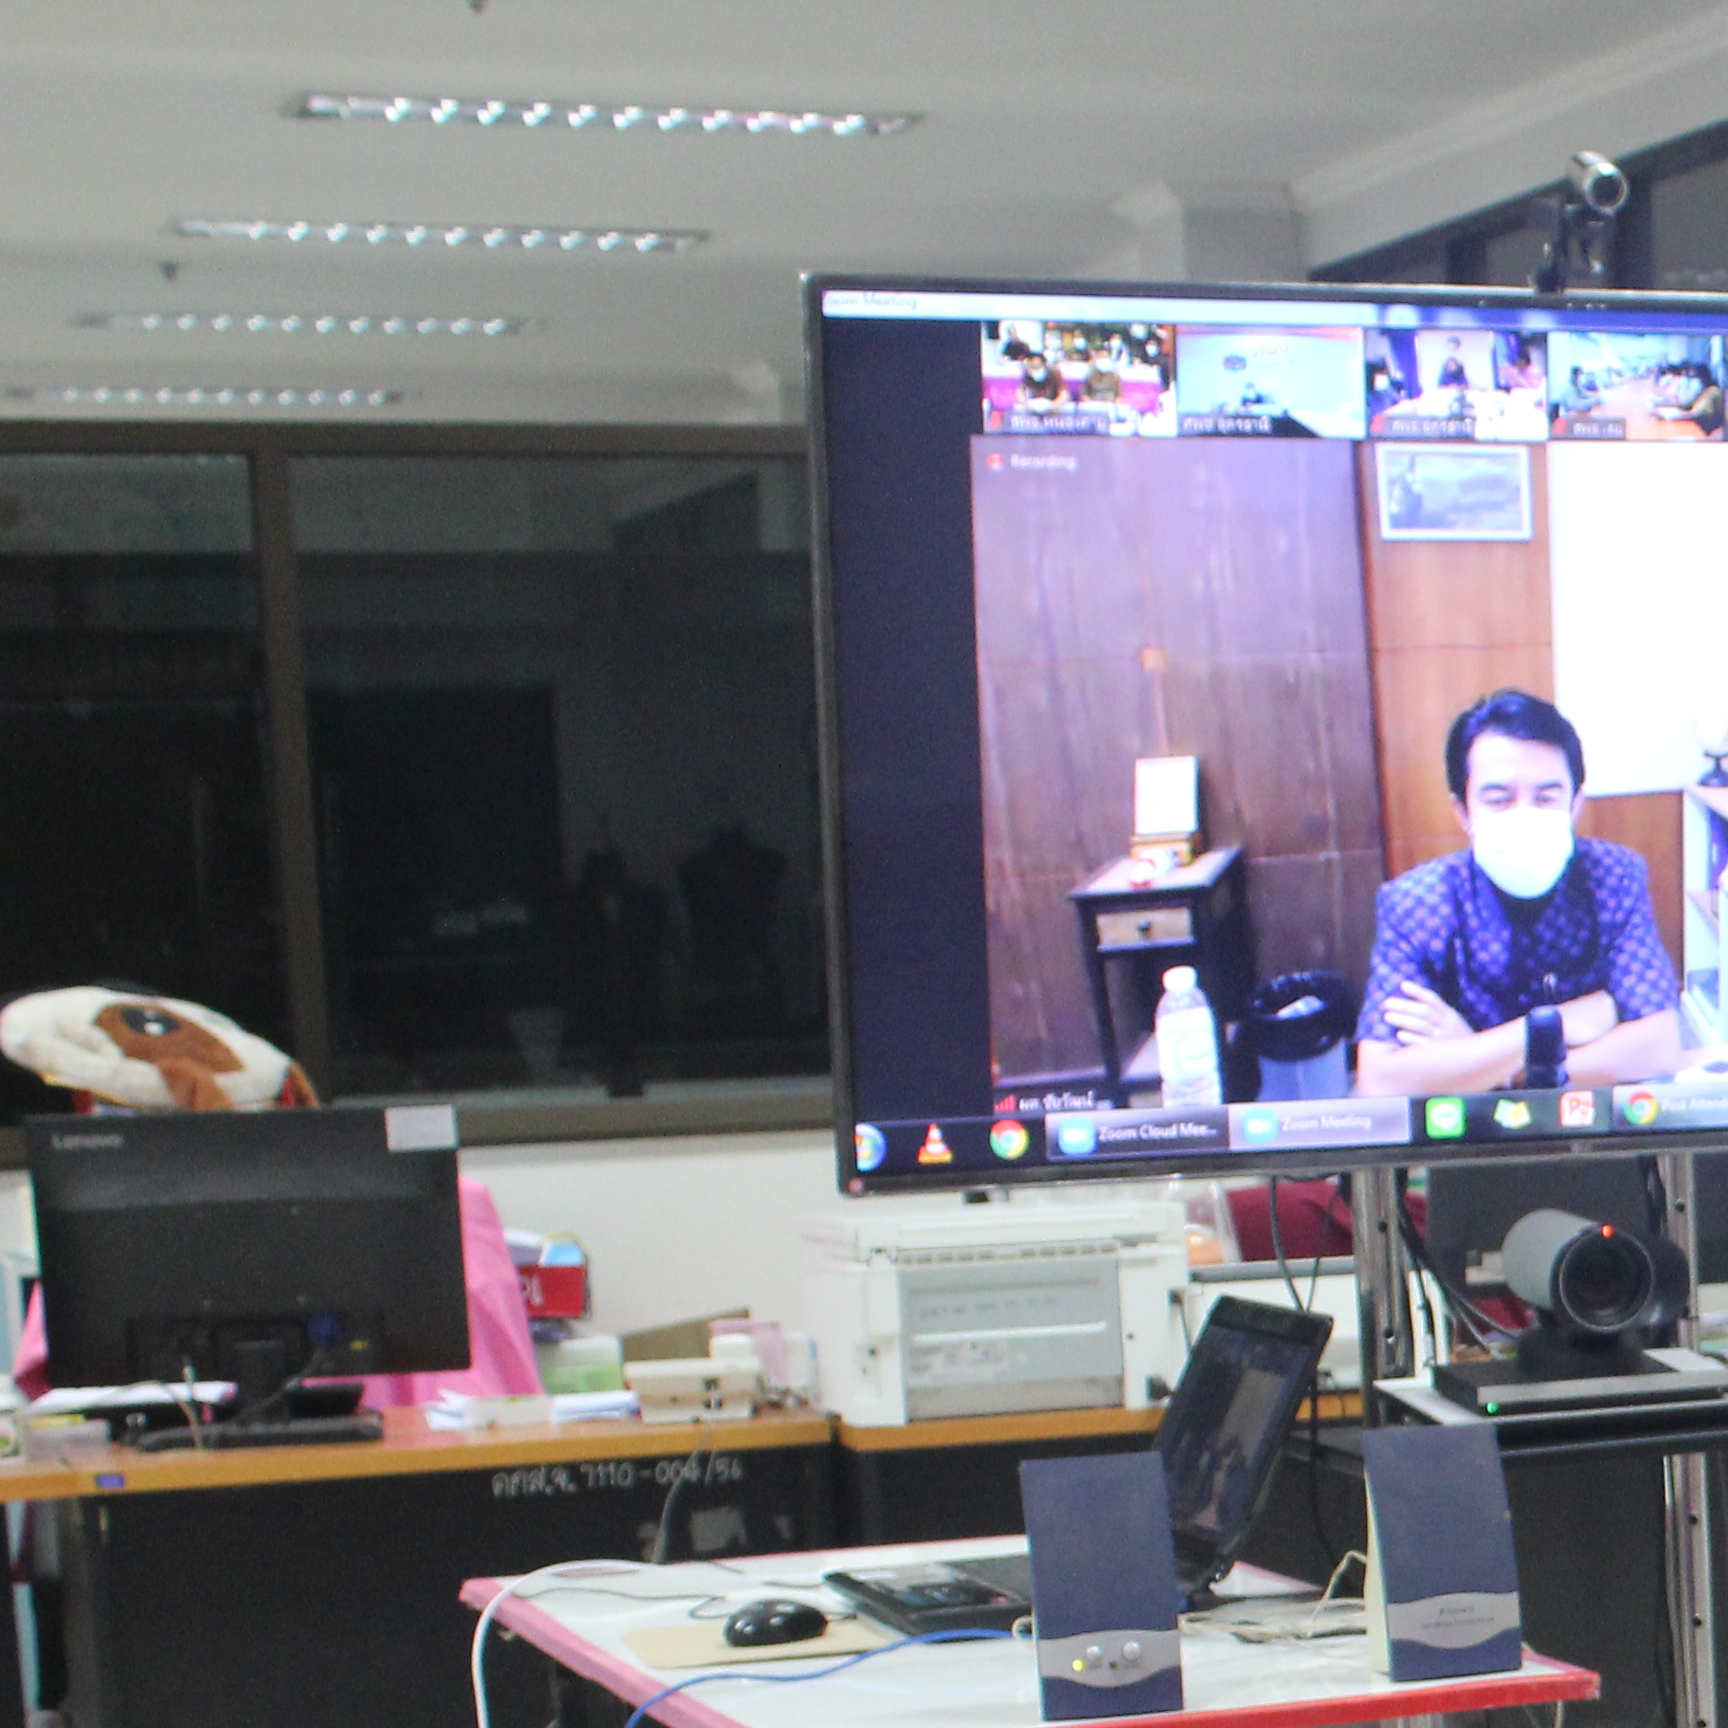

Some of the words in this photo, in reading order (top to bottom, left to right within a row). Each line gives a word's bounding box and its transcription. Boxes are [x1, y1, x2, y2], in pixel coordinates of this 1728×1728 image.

[1010, 453, 1077, 472] Recording
[1098, 1125, 1137, 1142] Zoom
[1139, 1123, 1177, 1140] Cloud
[1282, 1117, 1317, 1133] Zoom
[1320, 1113, 1371, 1132] Meeting
